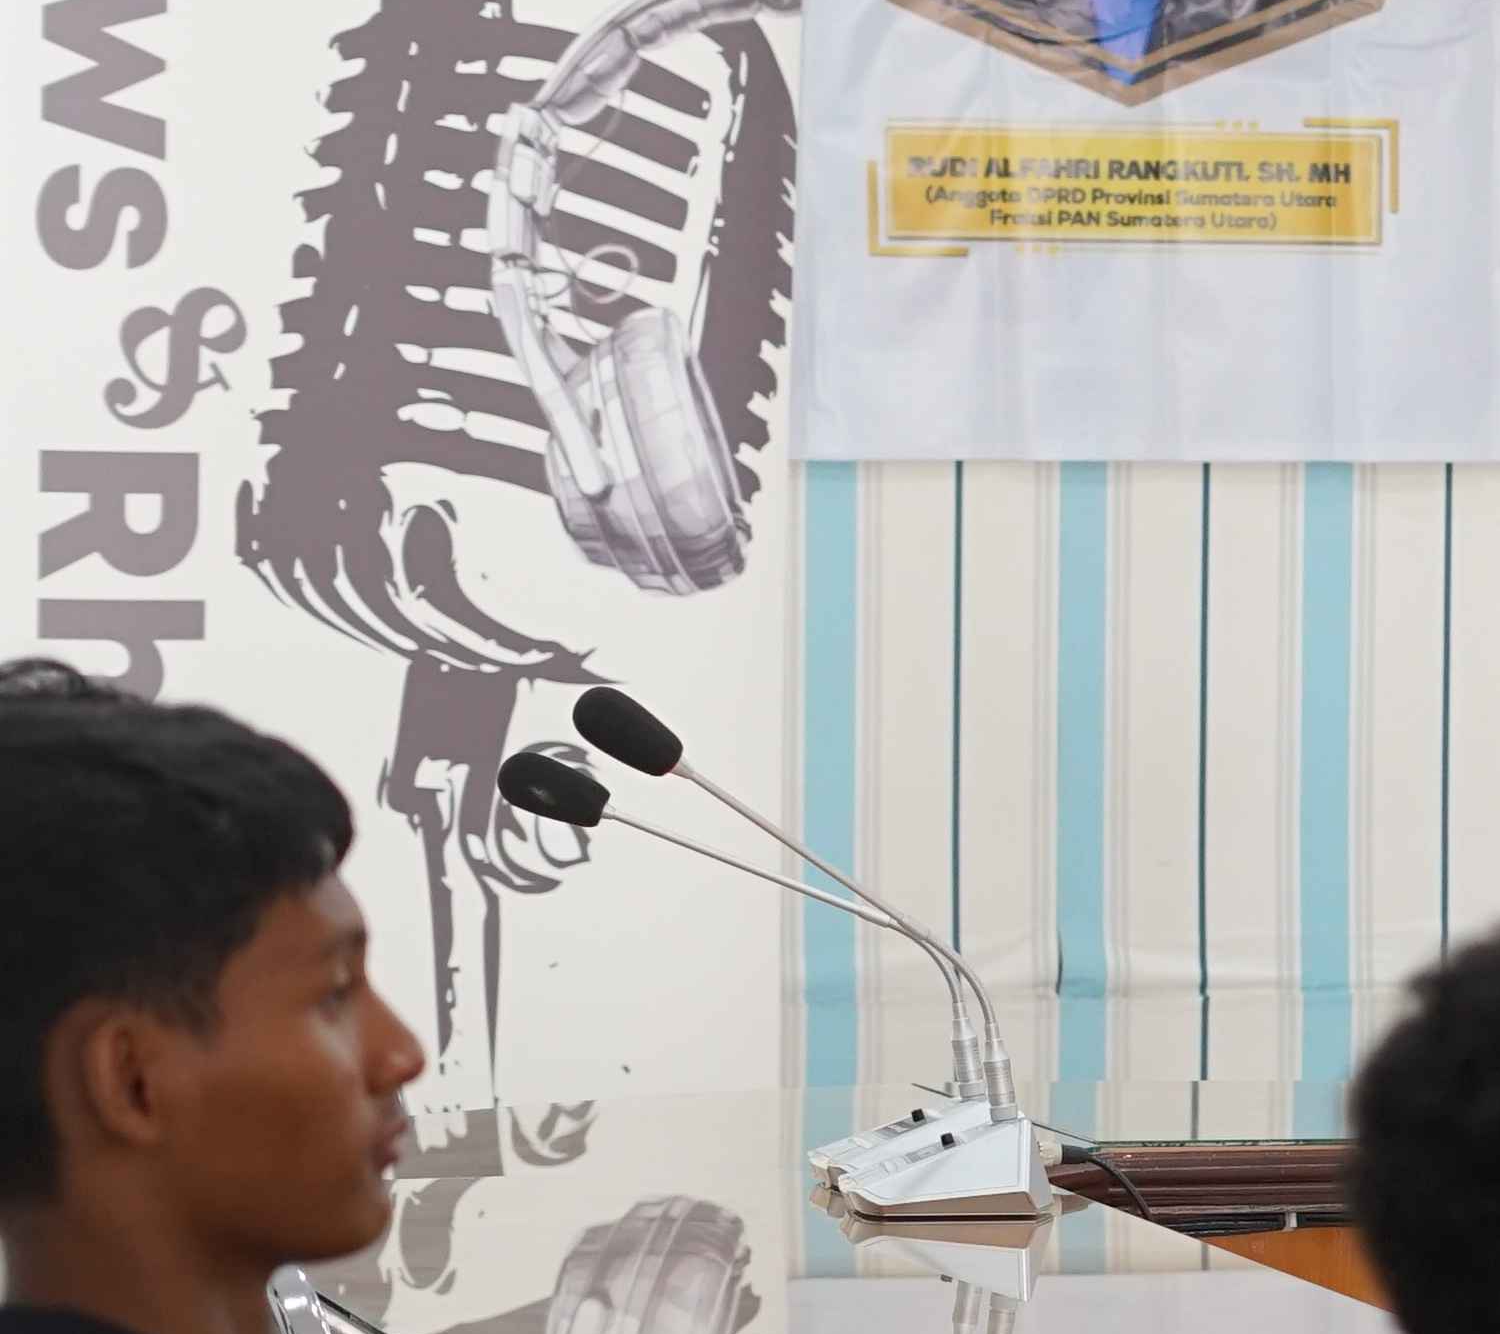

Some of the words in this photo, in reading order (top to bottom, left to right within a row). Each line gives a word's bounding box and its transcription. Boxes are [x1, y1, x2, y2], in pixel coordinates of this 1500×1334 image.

[1309, 163, 1351, 183] MH
[1027, 187, 1086, 204] DPRD
[1091, 189, 1171, 205] Provinsi
[1175, 190, 1274, 207] Sumatera
[1282, 192, 1336, 208] Utara
[1058, 211, 1100, 227] PAN
[1107, 211, 1206, 228] Sumatera
[1211, 212, 1277, 230] Utara)
[104, 286, 248, 430] &
